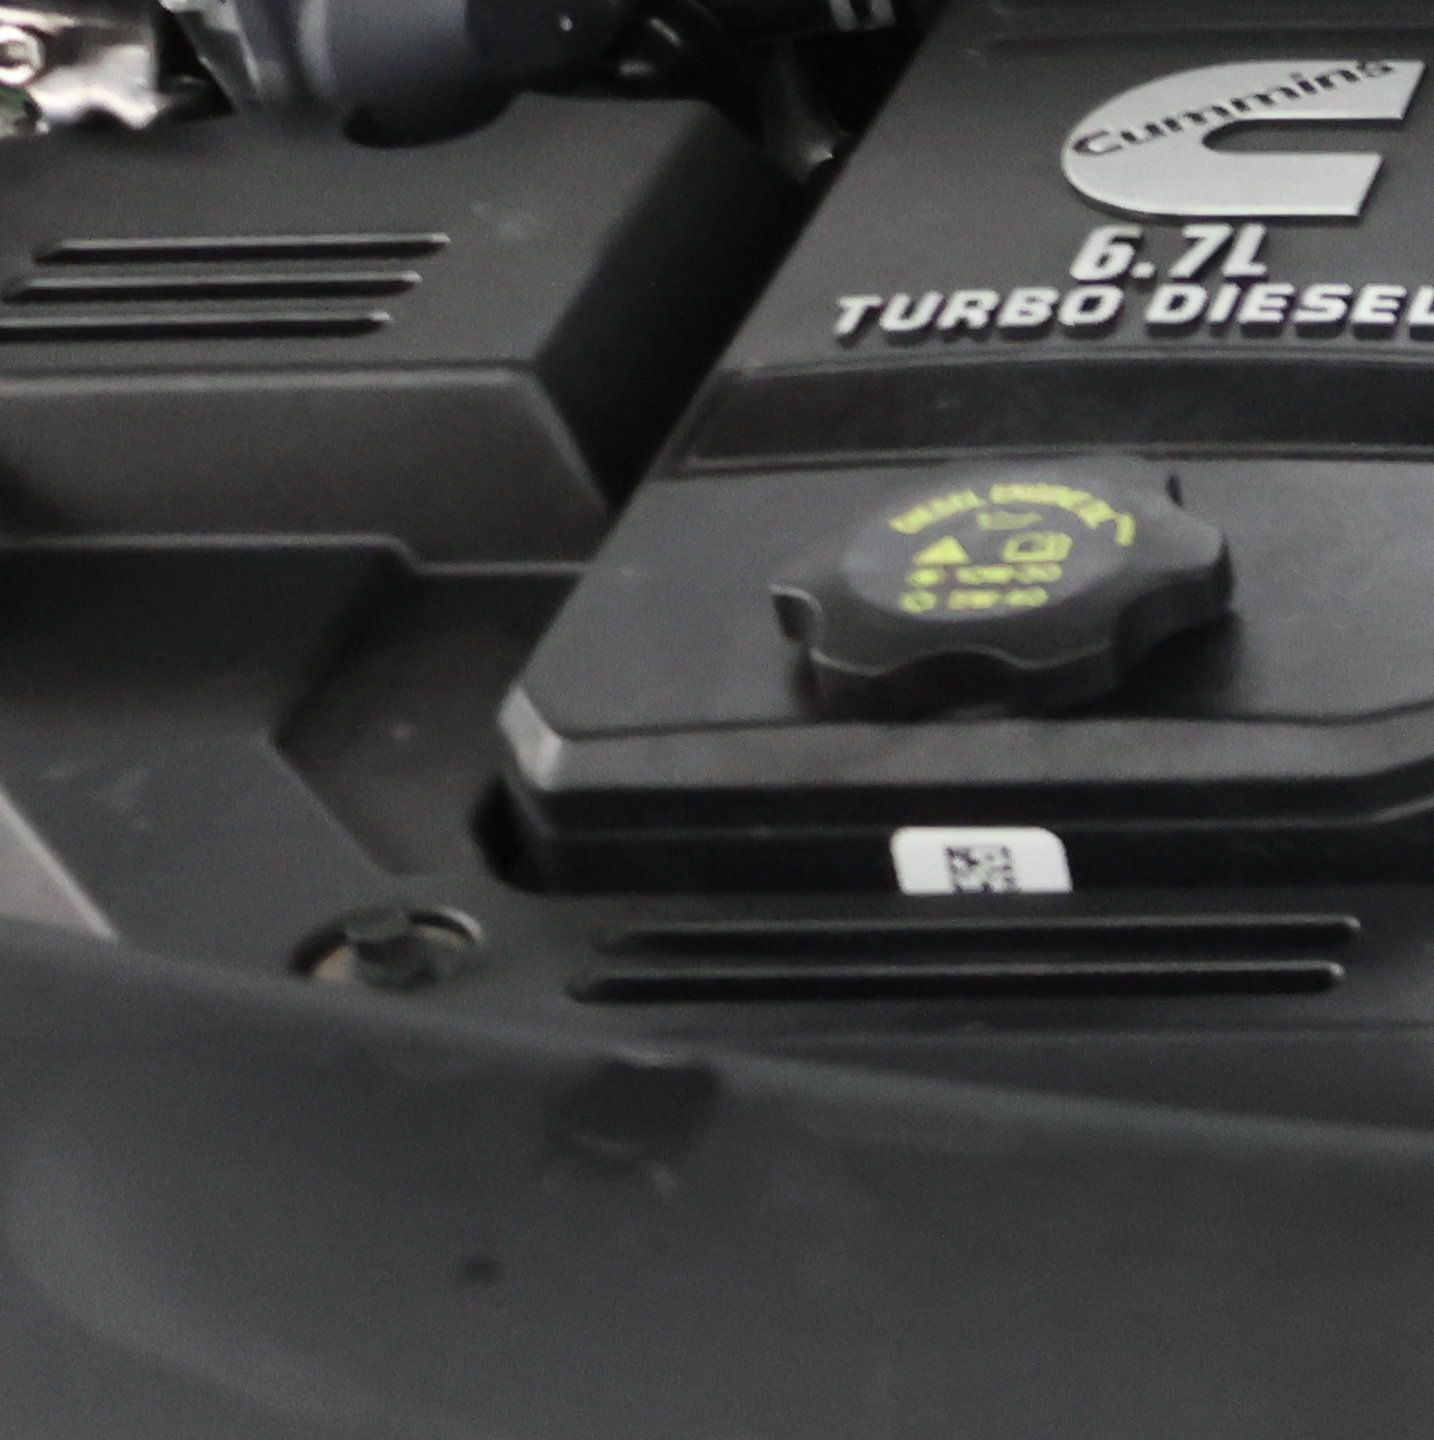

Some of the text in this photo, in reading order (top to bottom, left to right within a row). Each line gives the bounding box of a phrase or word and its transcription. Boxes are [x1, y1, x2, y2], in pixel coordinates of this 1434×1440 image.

[1072, 60, 1393, 156] Cummins
[1069, 222, 1269, 282] 6.7L
[835, 285, 1126, 336] TURBO
